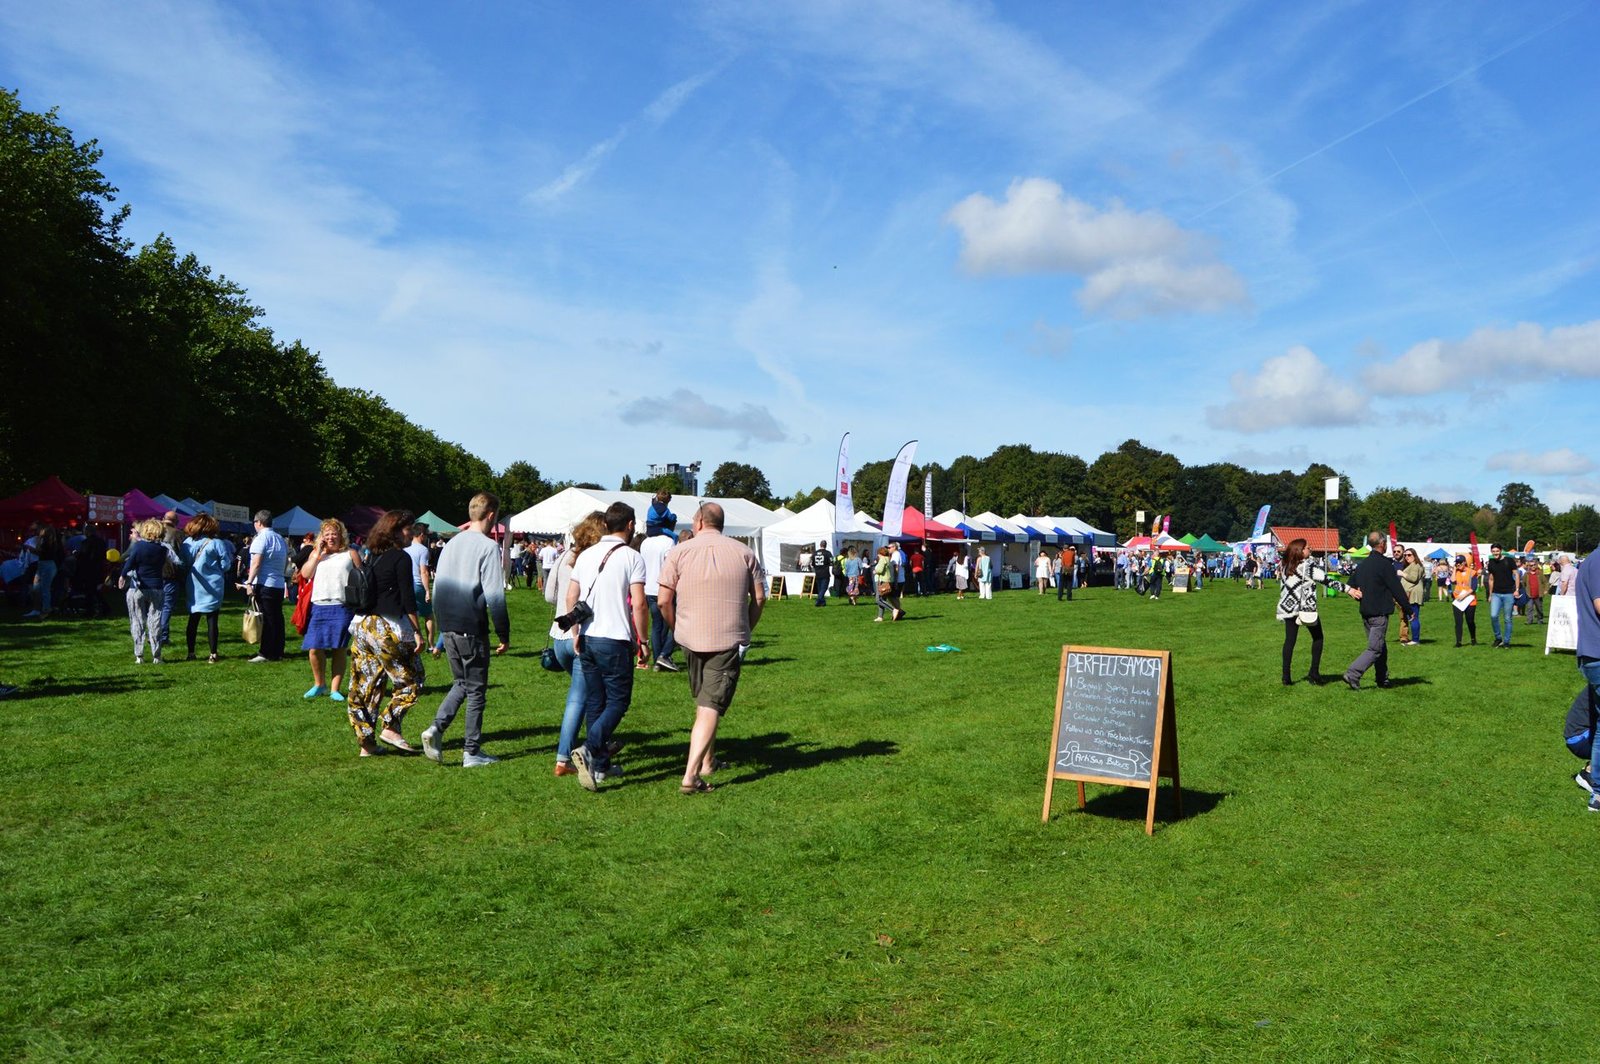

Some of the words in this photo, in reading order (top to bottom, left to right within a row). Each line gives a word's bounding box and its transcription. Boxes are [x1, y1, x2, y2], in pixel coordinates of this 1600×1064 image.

[815, 555, 825, 566] 52
[1066, 653, 1118, 687] PERFECT
[1118, 656, 1161, 695] SAMOSA
